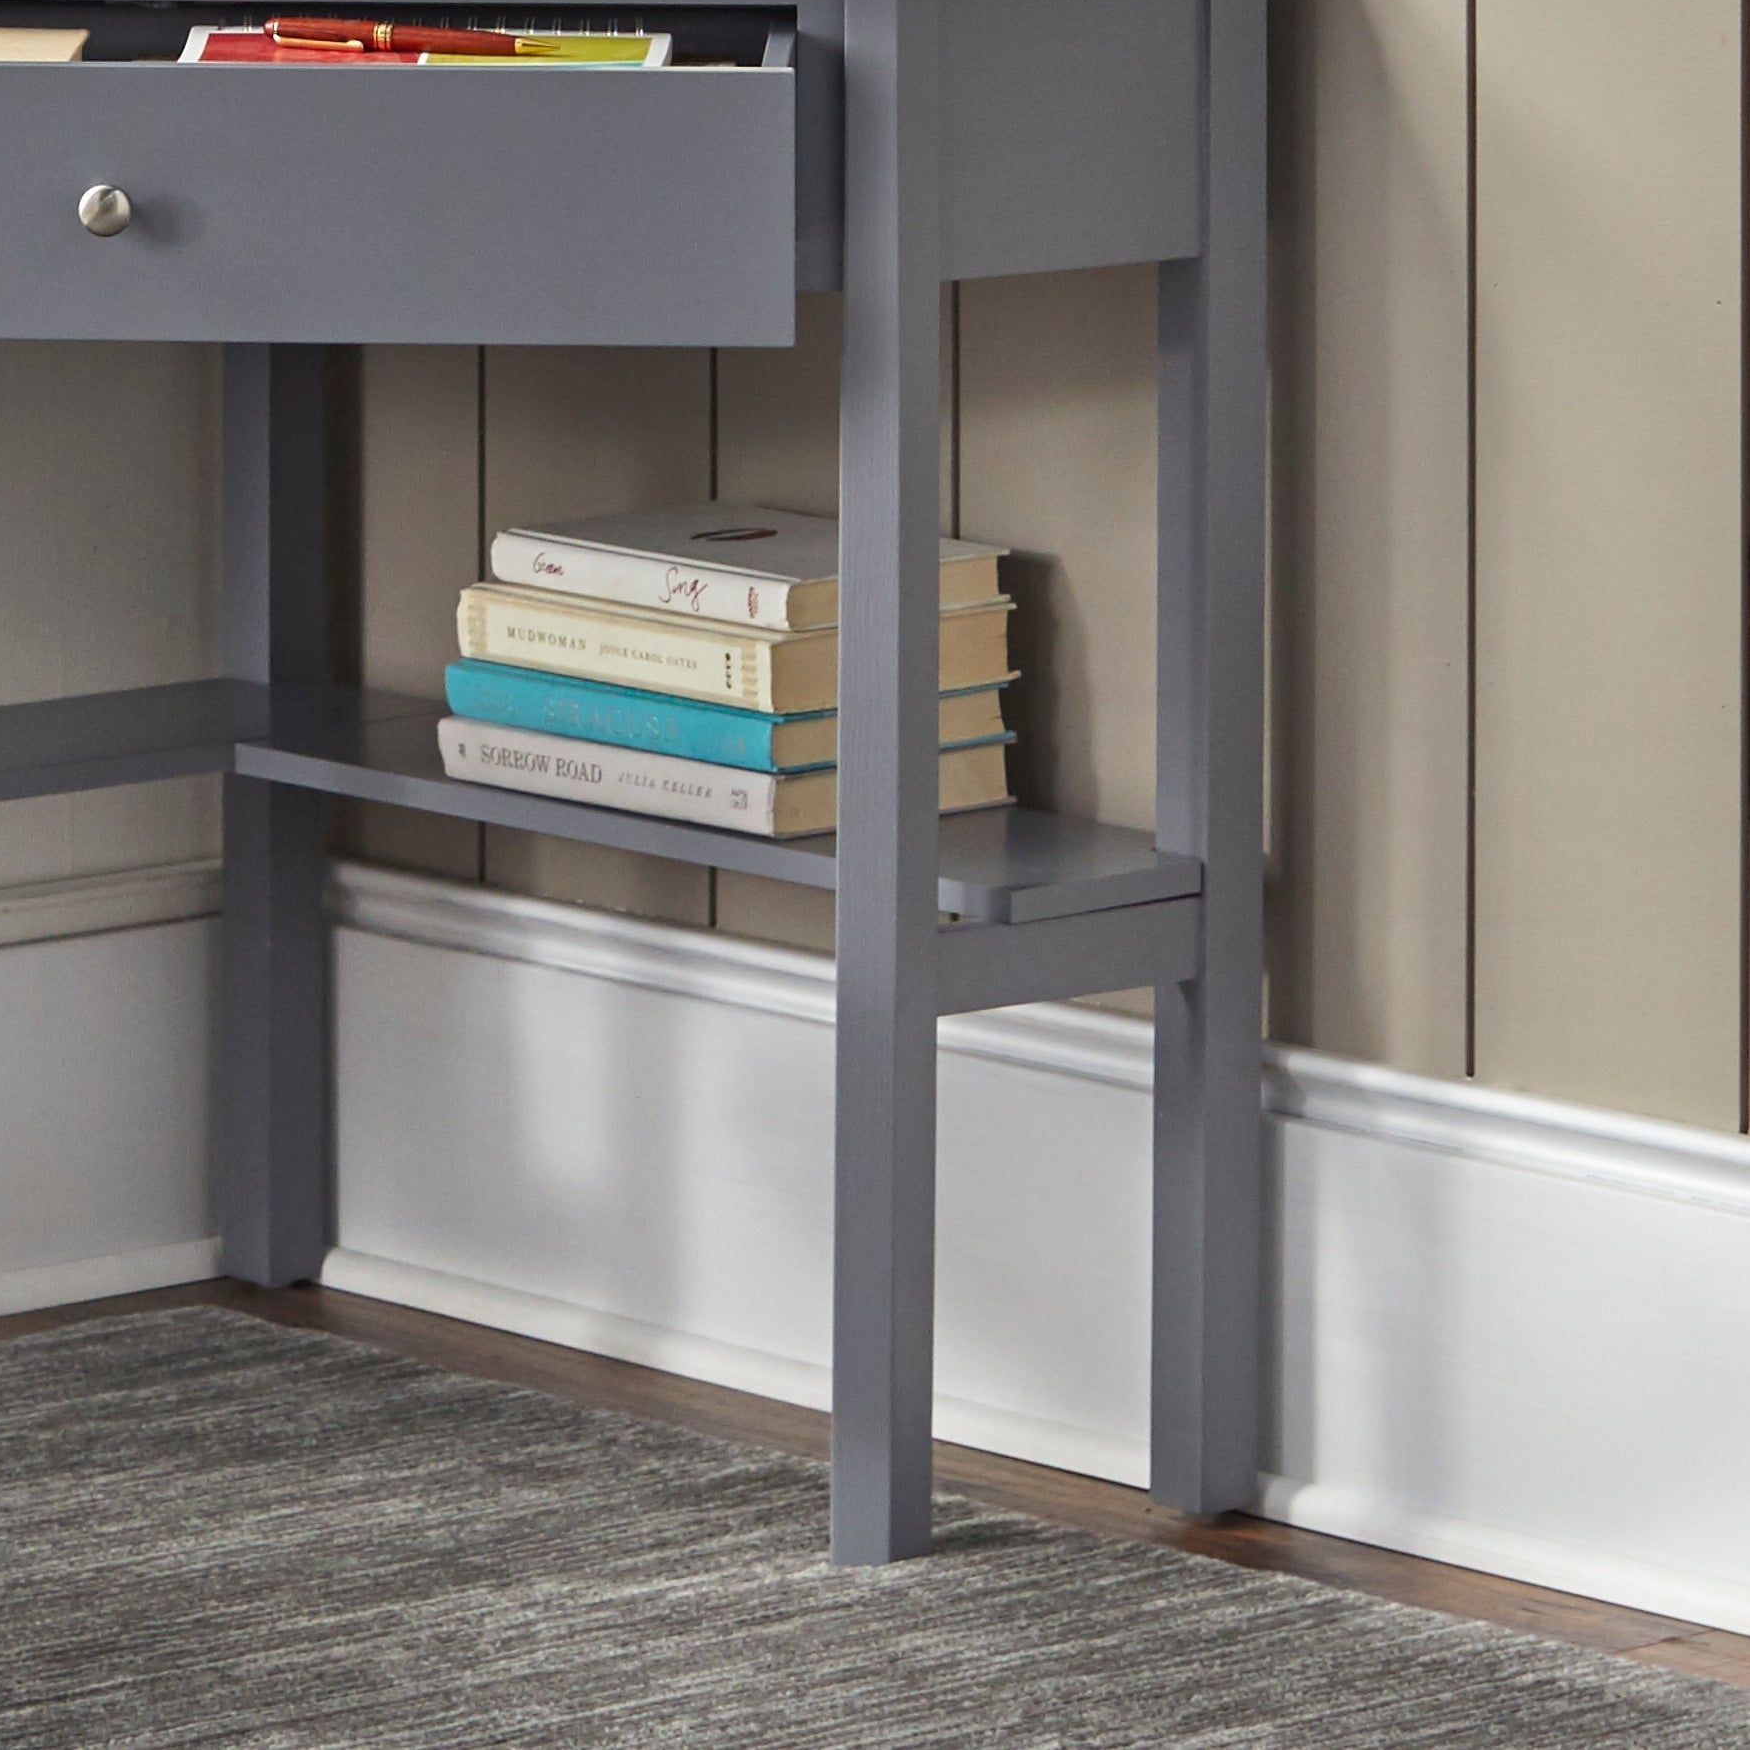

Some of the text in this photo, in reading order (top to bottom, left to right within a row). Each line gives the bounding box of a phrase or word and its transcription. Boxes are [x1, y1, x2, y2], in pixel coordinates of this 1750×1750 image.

[506, 626, 587, 651] MUDWOMAN
[481, 744, 603, 784] SORROW ROAD
[618, 772, 713, 798] JULIA KELLER
